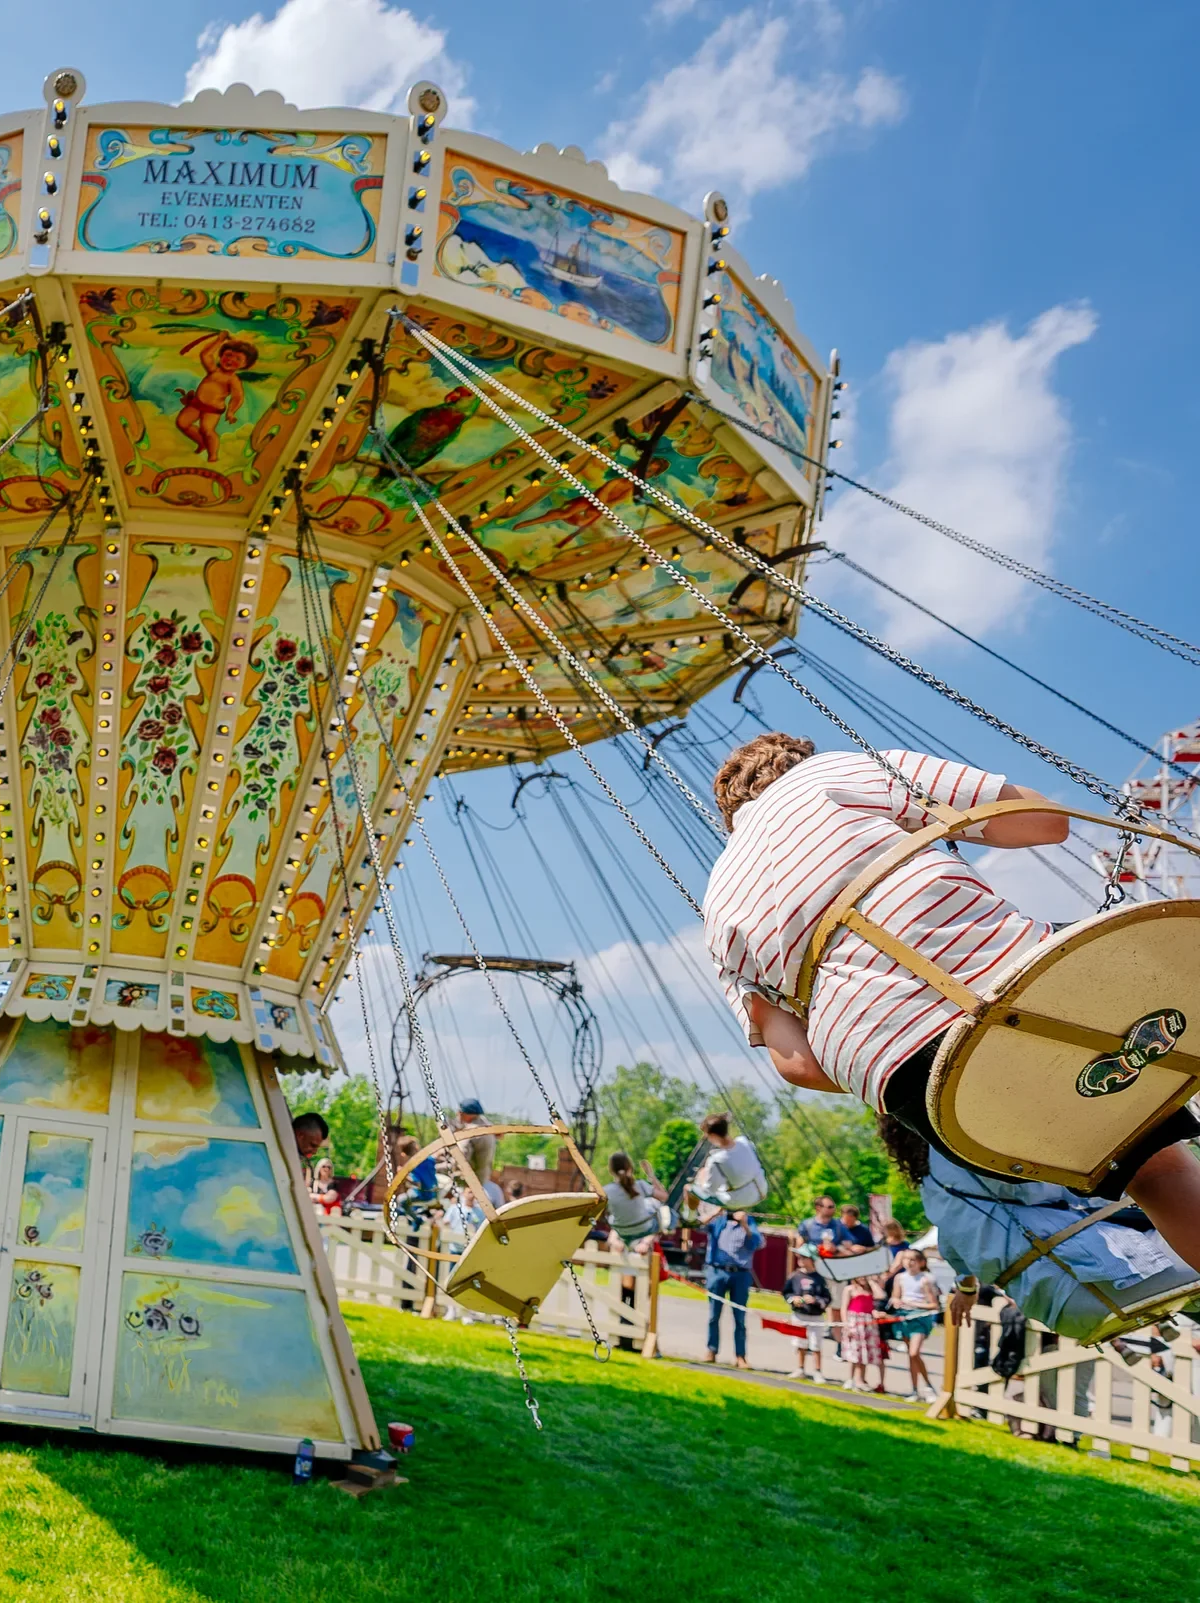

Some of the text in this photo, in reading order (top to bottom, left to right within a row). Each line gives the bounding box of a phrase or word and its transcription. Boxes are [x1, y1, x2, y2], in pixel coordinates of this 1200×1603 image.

[143, 159, 320, 190] MAXIMUM
[161, 191, 304, 210] EVENEMENTEN
[138, 212, 316, 233] TEL: 0413-274682
